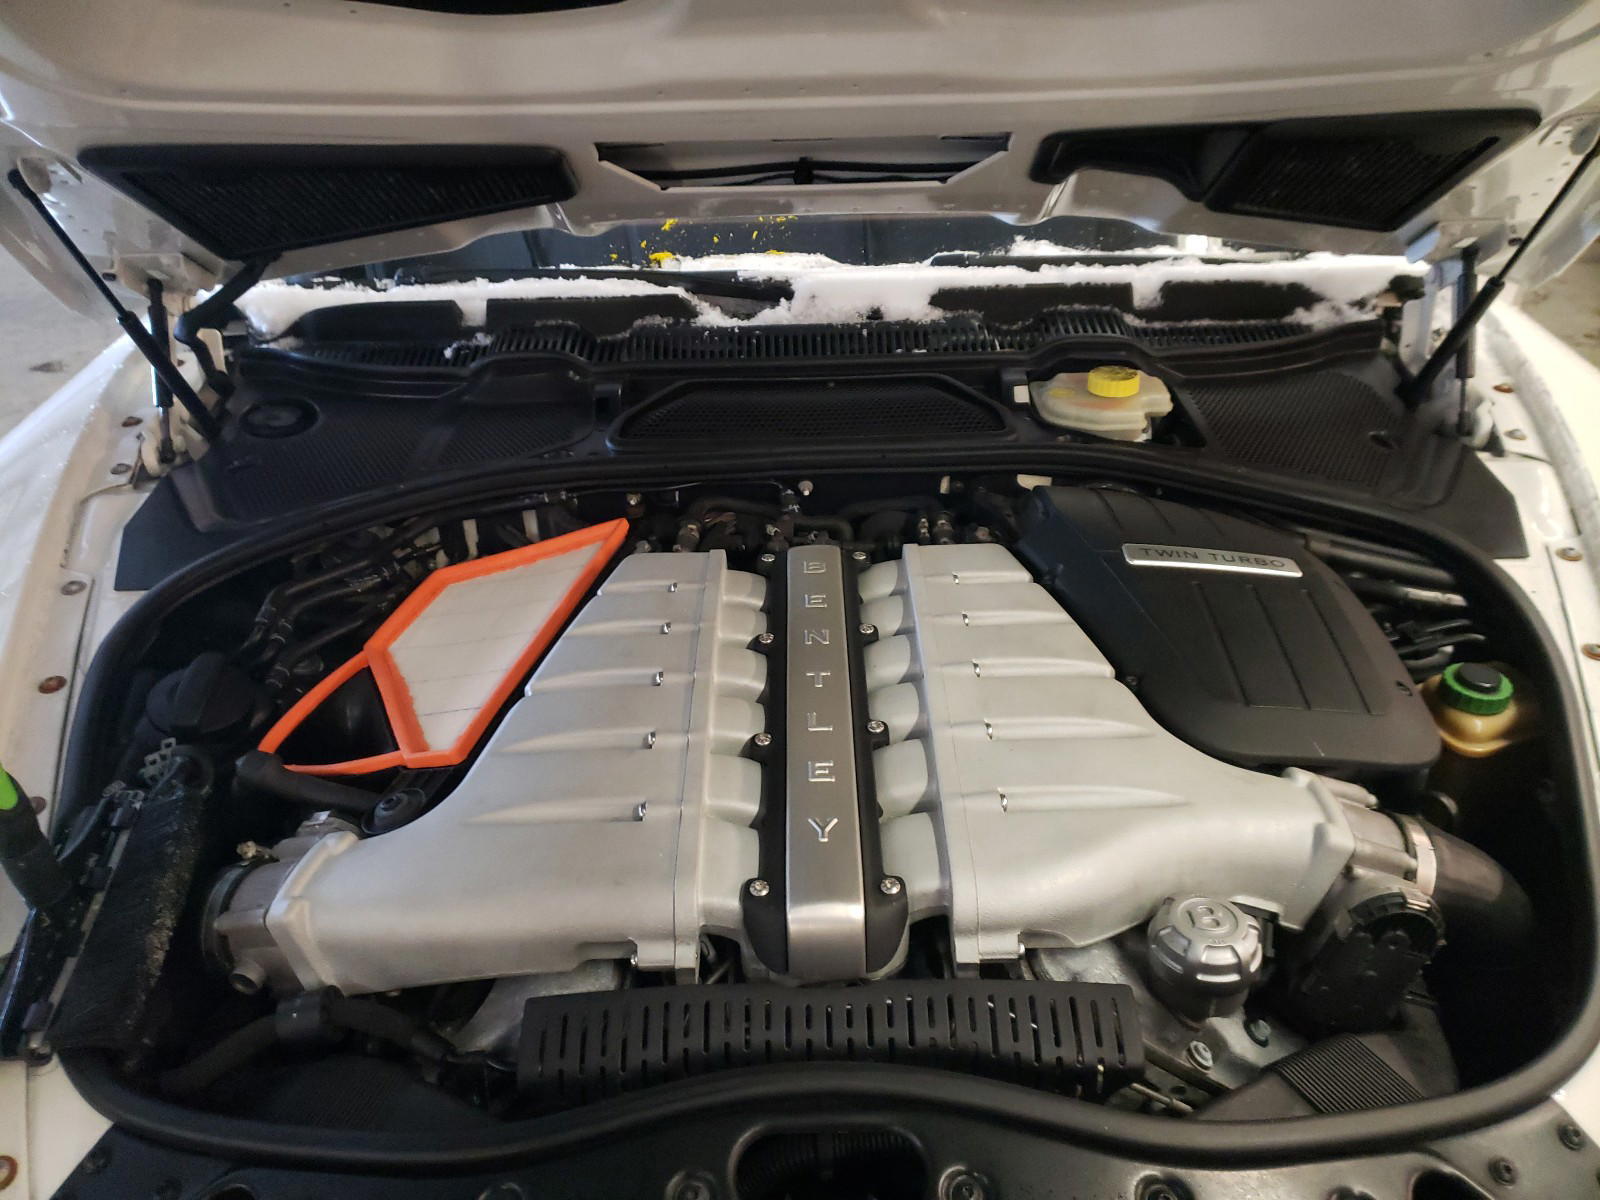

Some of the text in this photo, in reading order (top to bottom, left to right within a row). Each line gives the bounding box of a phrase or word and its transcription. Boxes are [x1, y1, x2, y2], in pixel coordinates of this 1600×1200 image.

[1141, 547, 1286, 568] TWIN TURBO
[802, 560, 839, 843] BENTLEY
[1186, 903, 1228, 931] B
